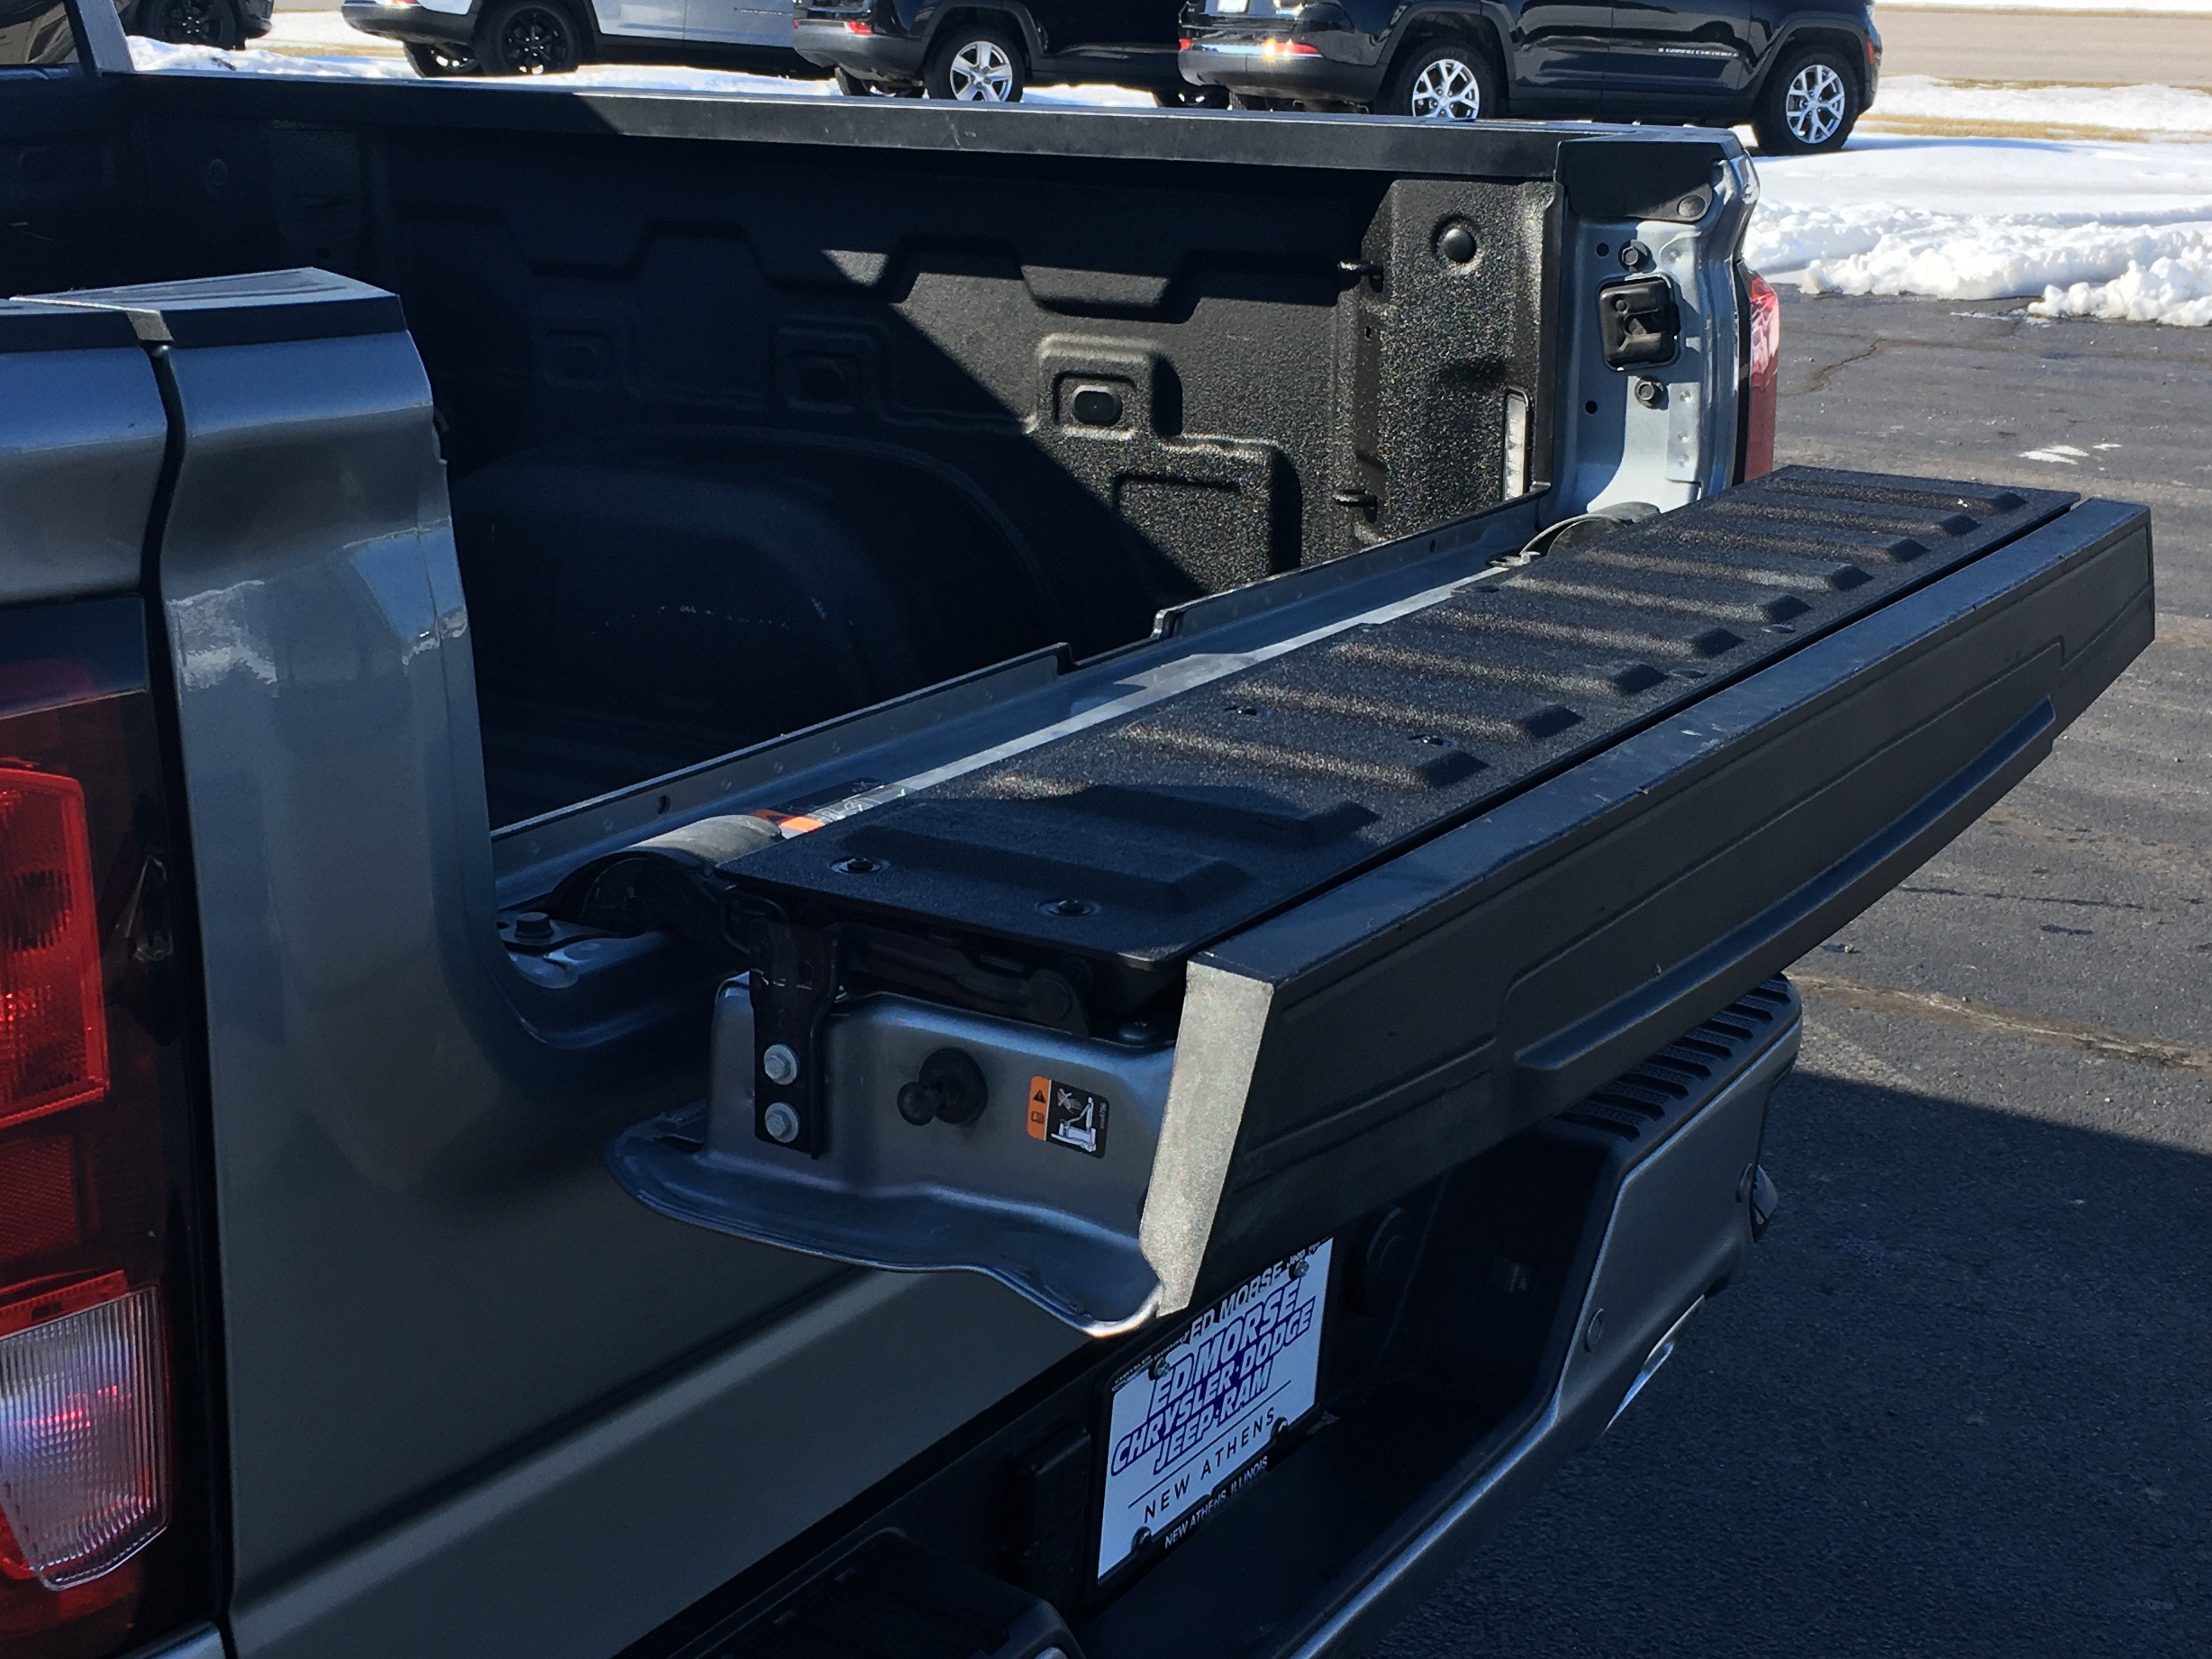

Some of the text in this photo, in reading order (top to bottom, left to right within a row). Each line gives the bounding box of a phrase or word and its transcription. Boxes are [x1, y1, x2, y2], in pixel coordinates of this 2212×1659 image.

[1149, 1276, 1302, 1420] ED MORSE
[1190, 1308, 1215, 1340] ED
[1144, 1407, 1274, 1523] NEW ATHENS
[1165, 1455, 1268, 1549] NEW ATHENS ILLINOIS
